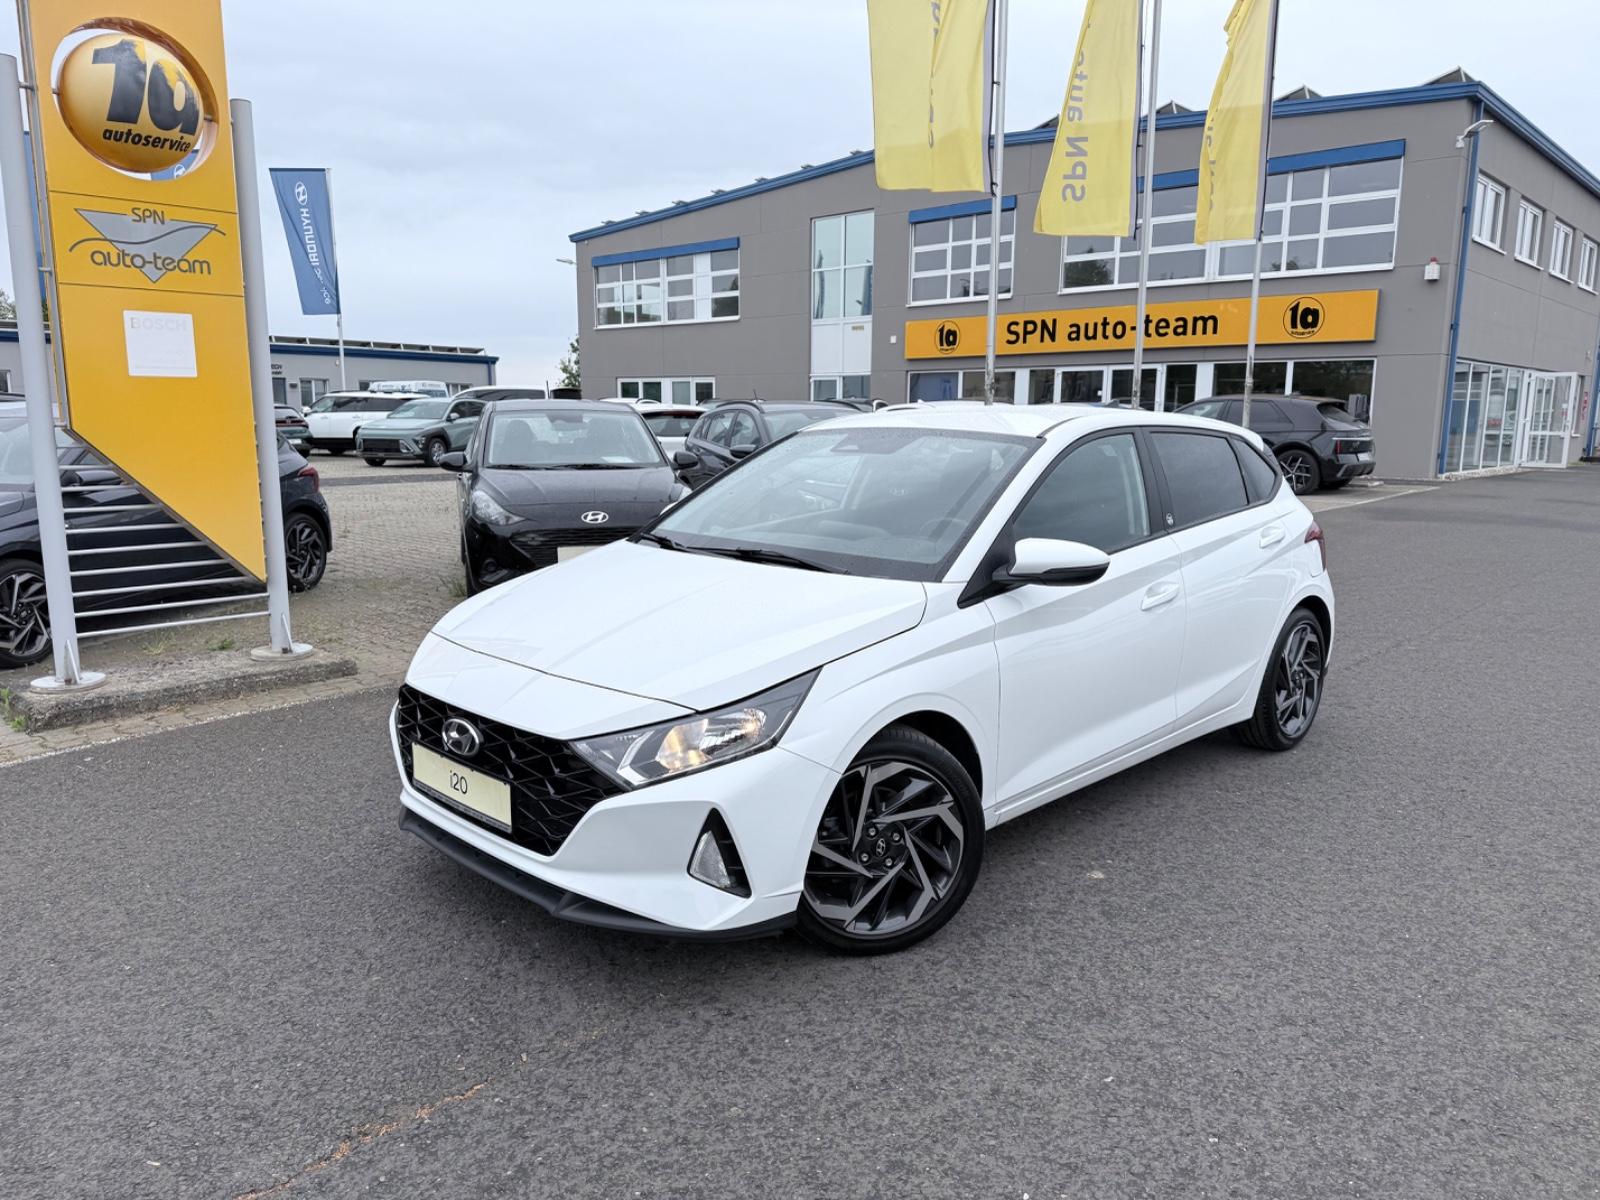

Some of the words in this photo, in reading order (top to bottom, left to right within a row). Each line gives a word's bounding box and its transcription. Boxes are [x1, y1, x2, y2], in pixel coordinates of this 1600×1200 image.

[102, 128, 192, 153] autoservice
[131, 207, 166, 225] SPN
[90, 249, 211, 275] auto-team
[130, 316, 187, 331] BOSCH
[1289, 300, 1320, 330] 1a
[938, 324, 958, 347] 1a
[1005, 318, 1057, 345] SPN
[1067, 314, 1219, 342] auto-team
